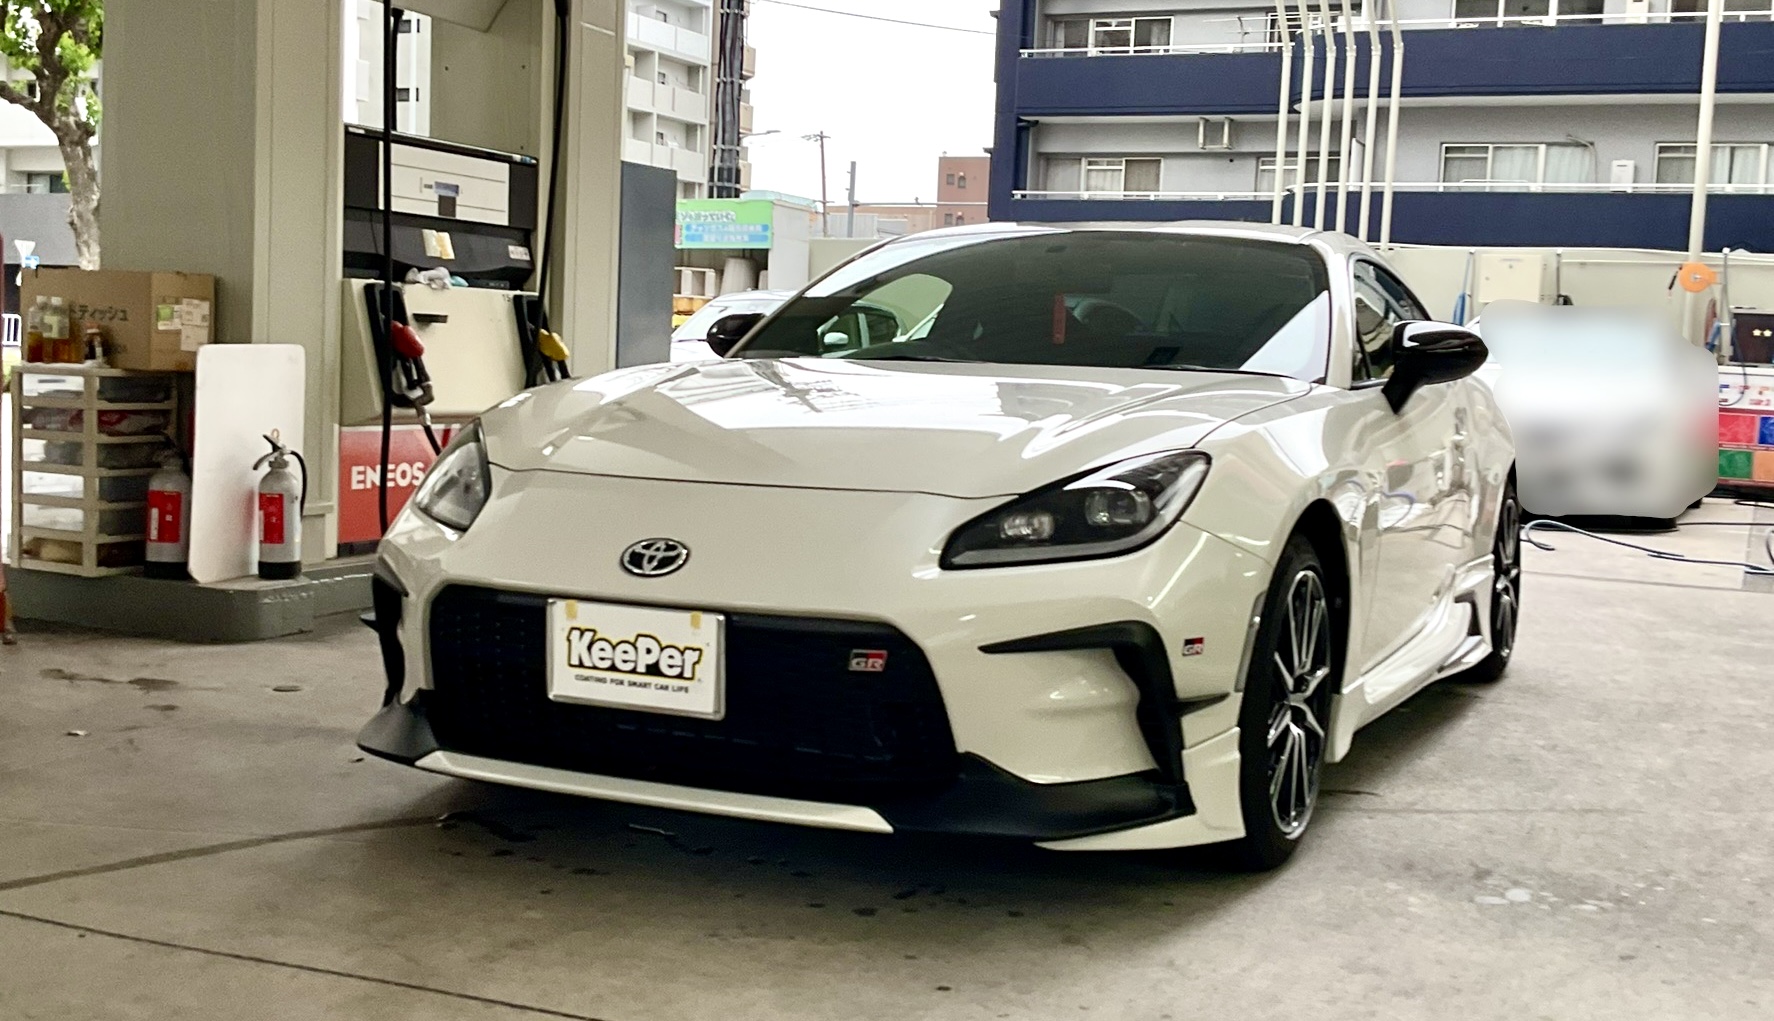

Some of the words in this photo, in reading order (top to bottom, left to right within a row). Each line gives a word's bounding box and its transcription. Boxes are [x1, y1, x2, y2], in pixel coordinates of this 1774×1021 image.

[351, 461, 426, 490] ENEOS
[567, 627, 703, 681] KeePer
[1183, 642, 1204, 655] GR
[850, 656, 885, 671] GR
[574, 674, 607, 684] COATING
[610, 678, 625, 687] FOR
[628, 680, 652, 690] SMART
[654, 683, 670, 692] CAR
[672, 685, 689, 694] LIFE
